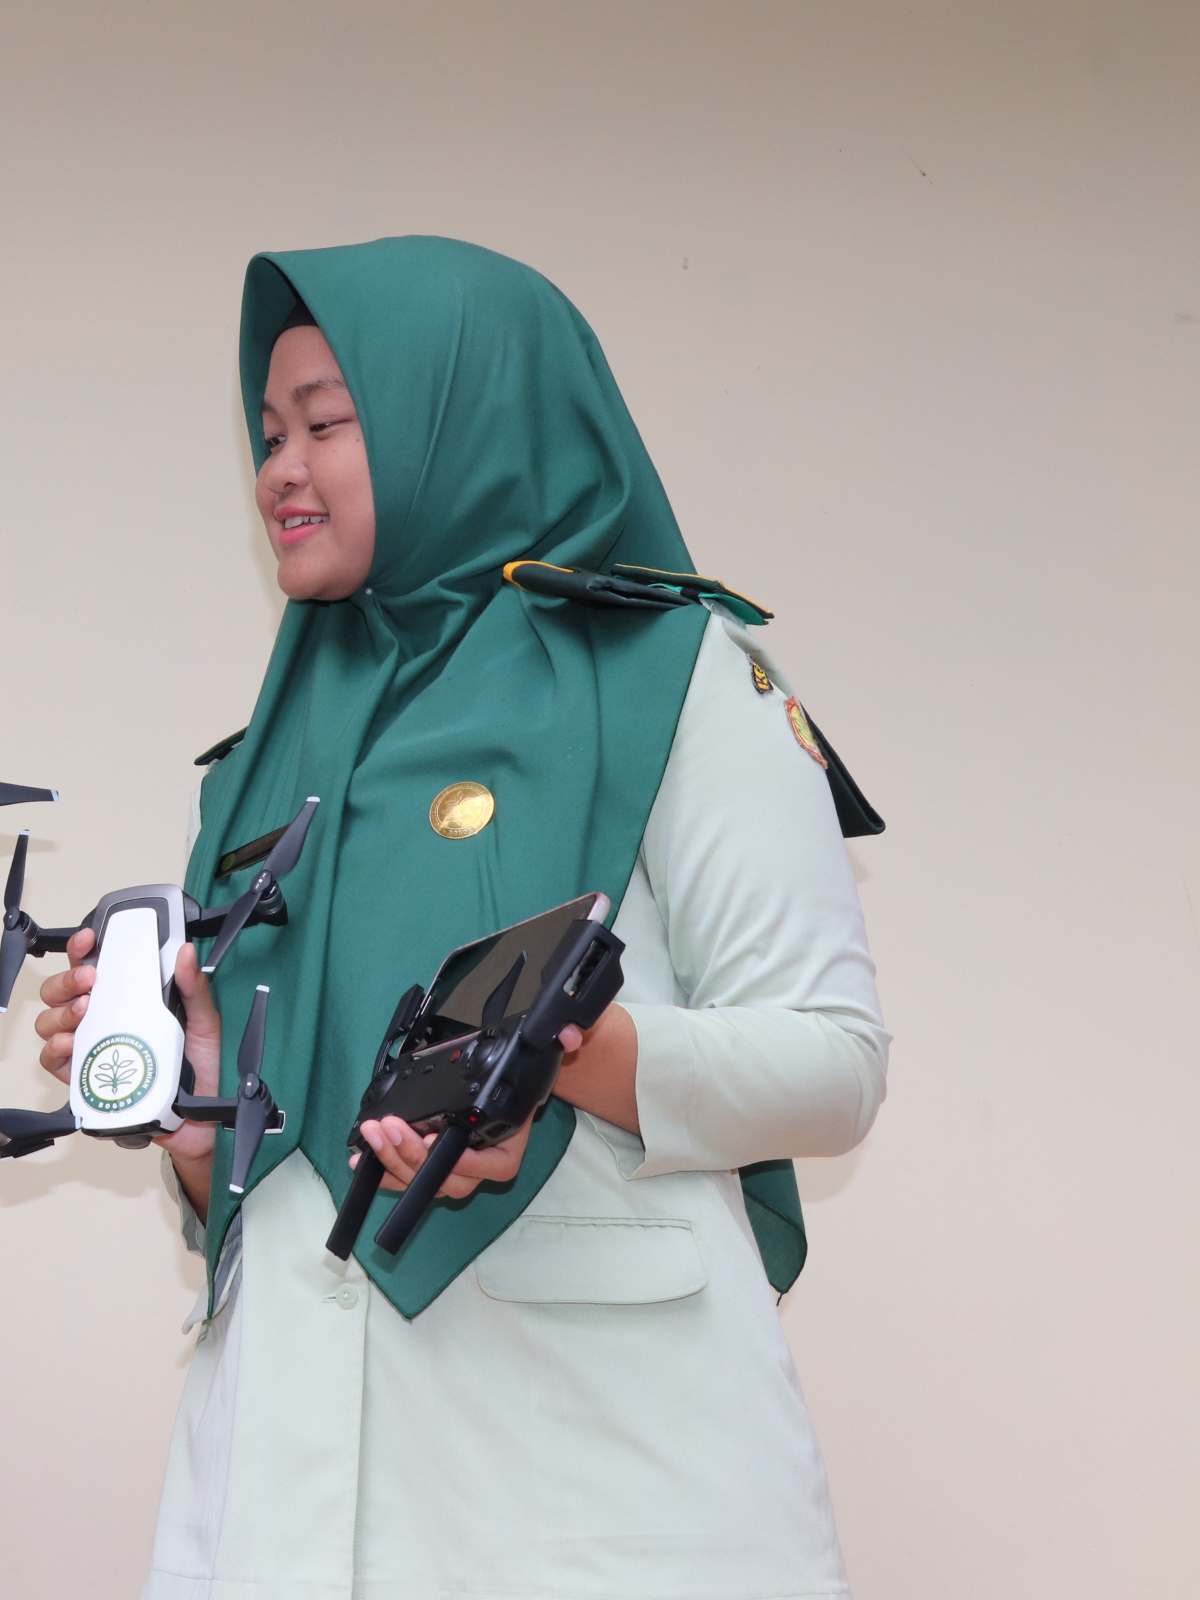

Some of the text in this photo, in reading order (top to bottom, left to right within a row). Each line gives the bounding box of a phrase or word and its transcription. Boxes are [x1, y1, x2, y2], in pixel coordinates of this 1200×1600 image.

[81, 1037, 154, 1097] POLITEKNIK PEMBANGUNAN PERTANIAN
[98, 1098, 132, 1109] BOGOR
